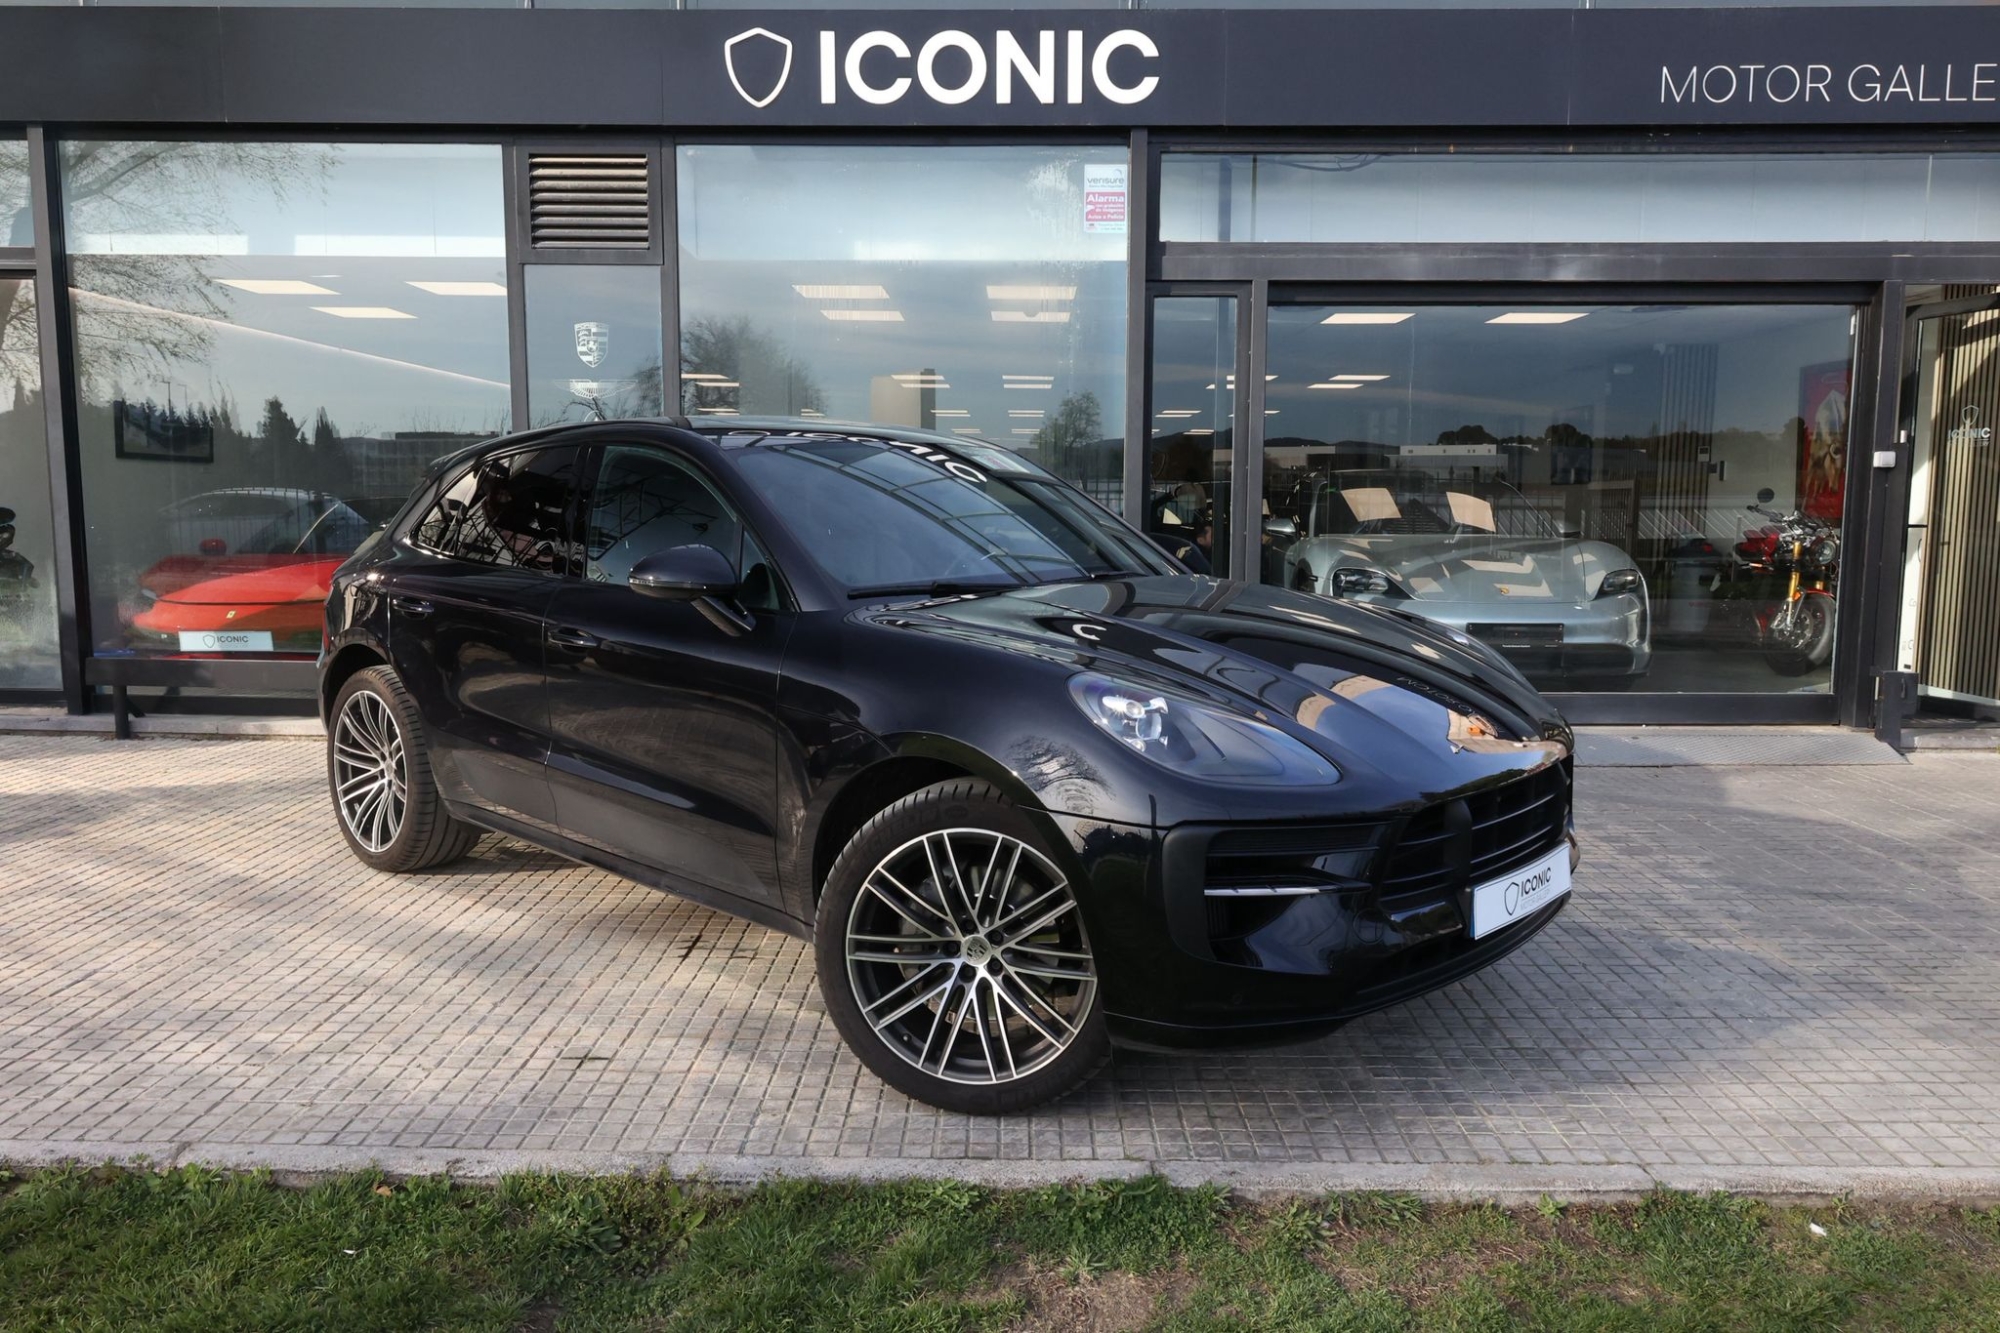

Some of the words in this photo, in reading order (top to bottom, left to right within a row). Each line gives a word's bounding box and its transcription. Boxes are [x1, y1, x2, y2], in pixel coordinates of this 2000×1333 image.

[820, 30, 1160, 105] ICONIC
[1660, 64, 1833, 104] MOTOR
[1847, 63, 2000, 103] GALLE
[1087, 193, 1124, 202] Alarma
[216, 635, 249, 643] ICONIC
[1521, 867, 1552, 897] ICONIC
